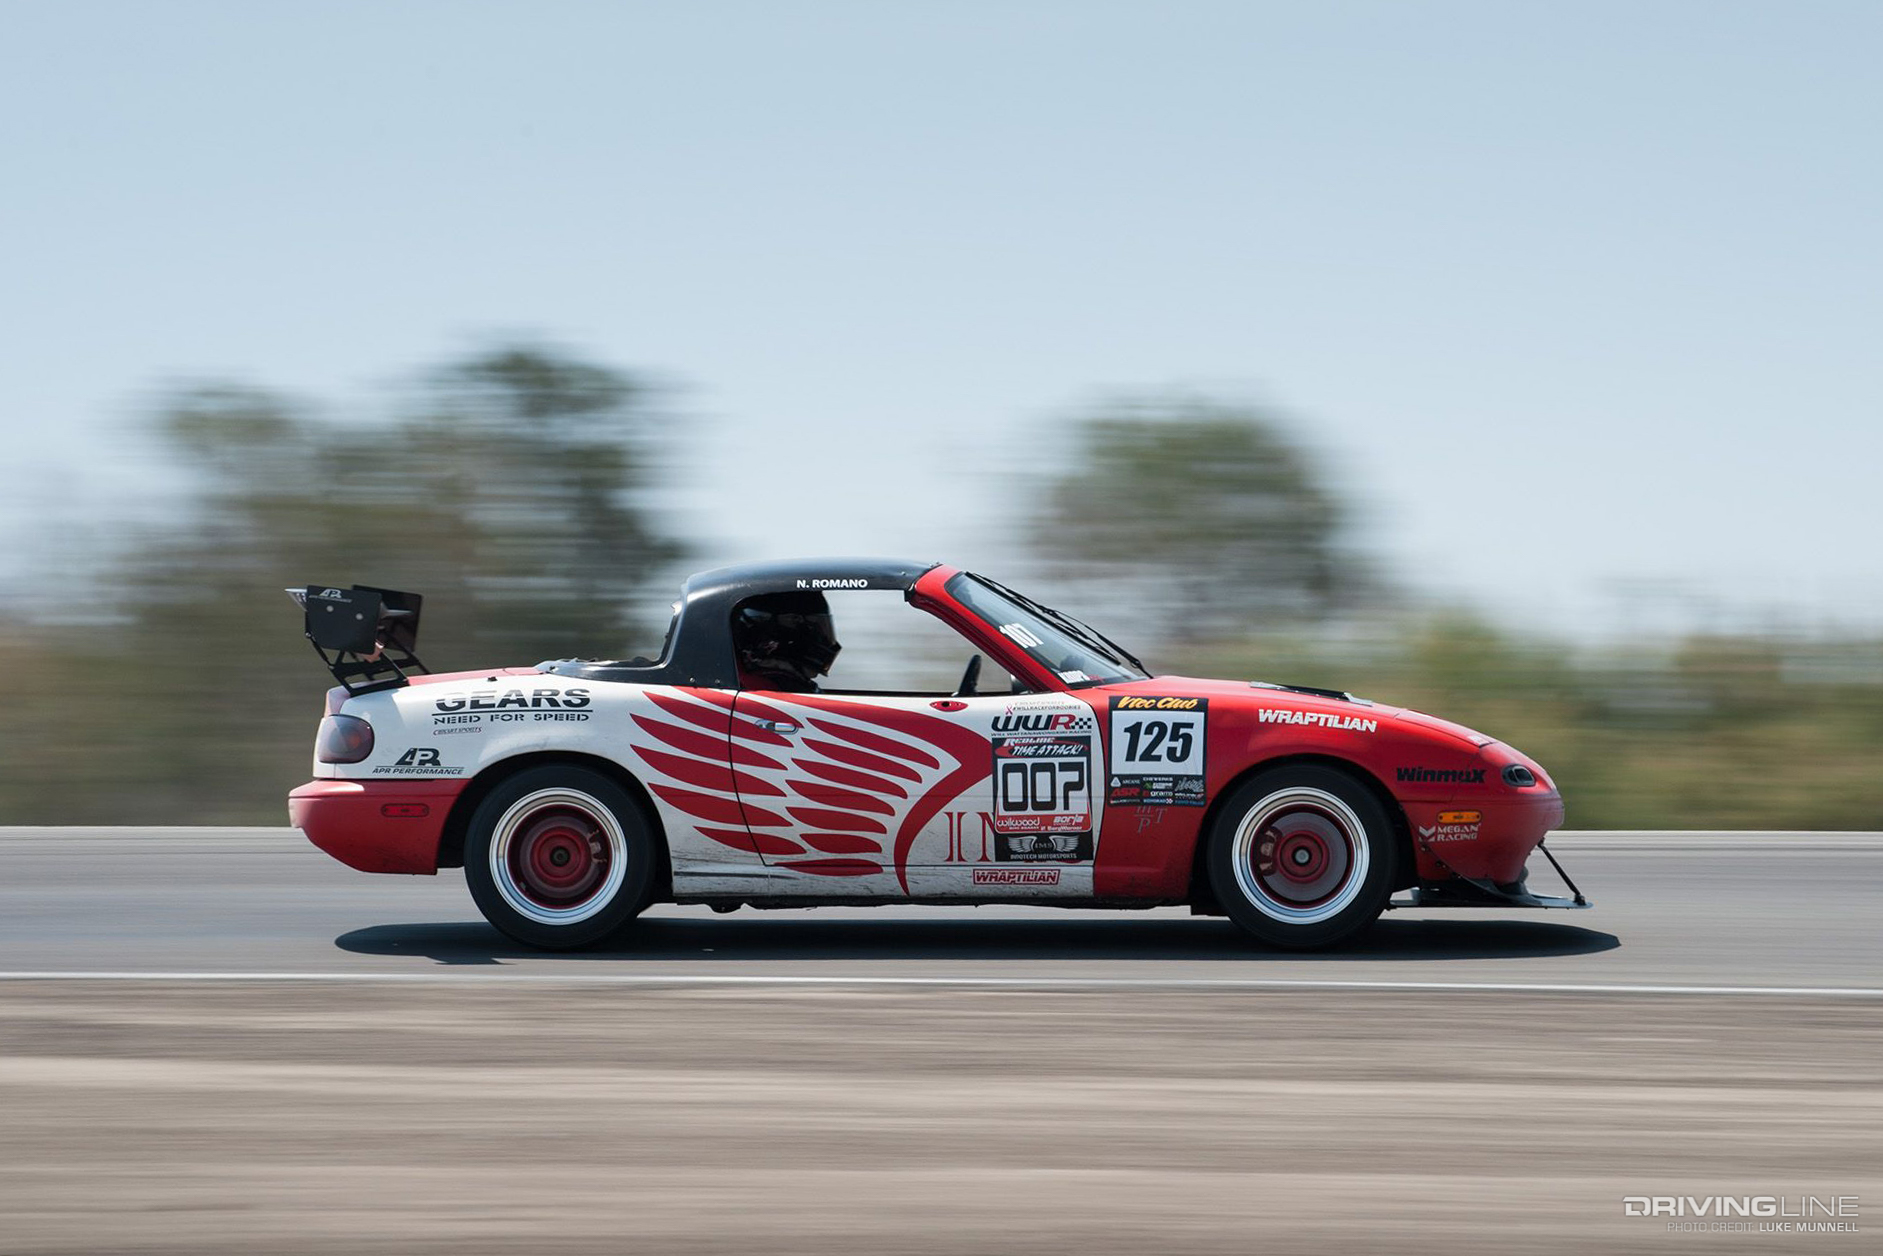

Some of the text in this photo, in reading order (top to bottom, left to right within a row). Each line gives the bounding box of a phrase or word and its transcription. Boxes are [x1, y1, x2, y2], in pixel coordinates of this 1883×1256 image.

[797, 579, 869, 589] N. ROMANO
[435, 688, 591, 712] GEARS
[1156, 697, 1199, 710] Club
[434, 713, 590, 725] NEED FOR SPEED
[991, 714, 1076, 732] WWR
[1258, 708, 1378, 733] WRAPTILIAN
[1124, 721, 1194, 763] 125
[394, 747, 442, 766] APR
[1012, 744, 1084, 757] TIME ATTACK!
[1002, 761, 1085, 812] 007
[997, 816, 1040, 827] wilwood
[1437, 825, 1479, 834] MEGAN
[1437, 833, 1478, 841] RACING
[974, 870, 1058, 884] WRAPTILIAN
